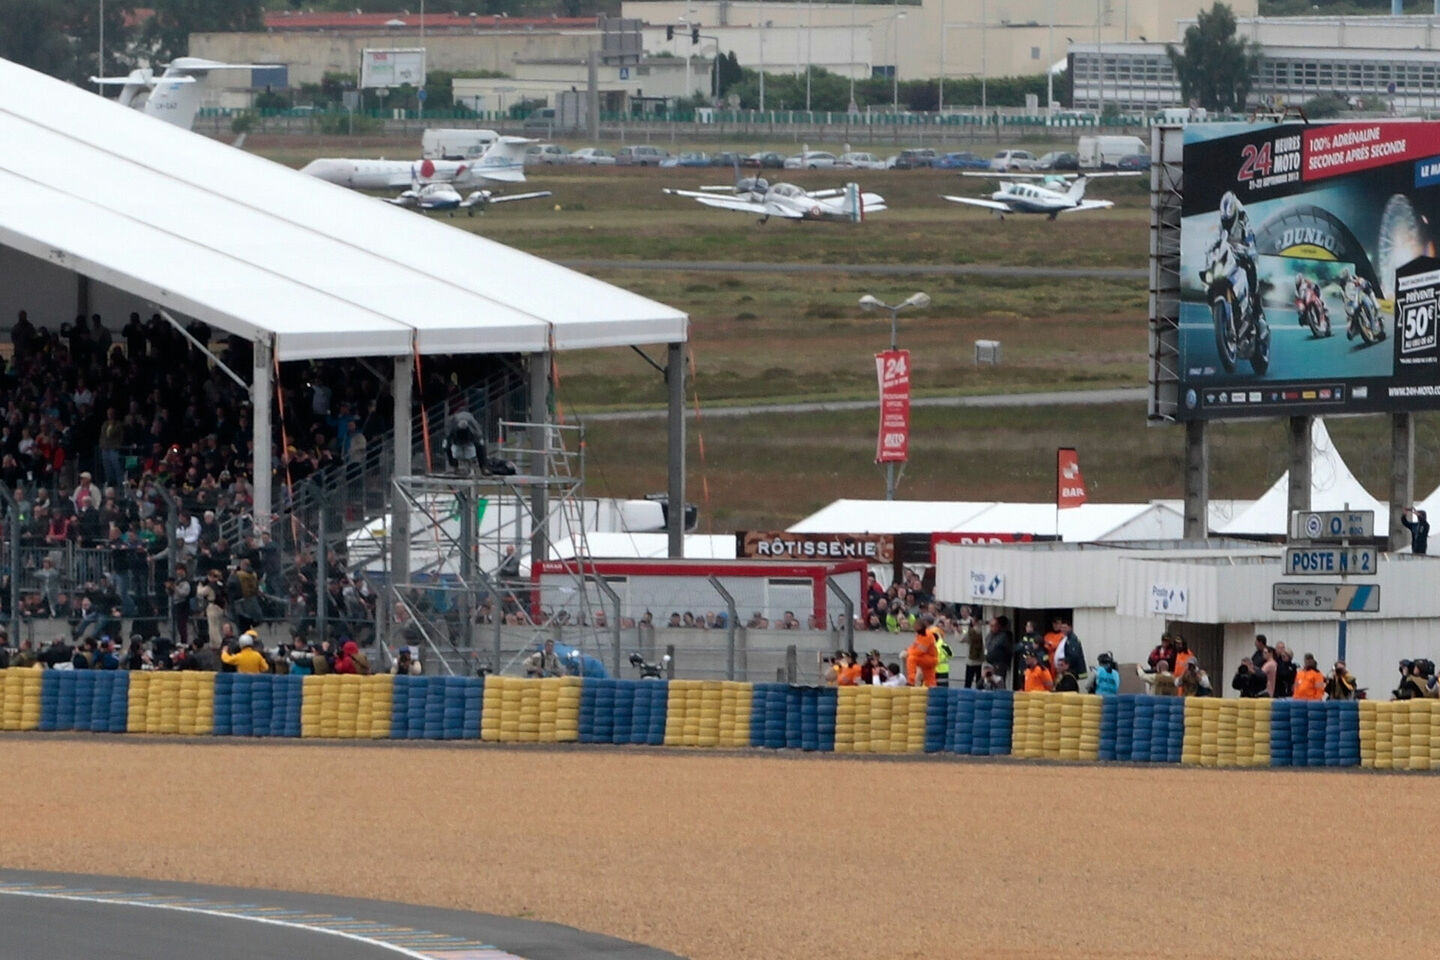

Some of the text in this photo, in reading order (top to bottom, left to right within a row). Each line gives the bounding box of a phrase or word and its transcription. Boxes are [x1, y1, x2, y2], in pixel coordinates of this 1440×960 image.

[1274, 135, 1301, 153] HEURES
[1310, 127, 1381, 152] 100% ADRÉNALINE
[1237, 141, 1273, 181] 24
[1273, 151, 1300, 173] MOTO
[1309, 139, 1407, 170] SECONDE APRÈS SECONDE
[885, 356, 907, 380] 24
[1062, 487, 1085, 497] BAR
[758, 538, 877, 557] RÔTISSERIE
[1292, 552, 1334, 571] POSTE
[1361, 552, 1370, 571] 2
